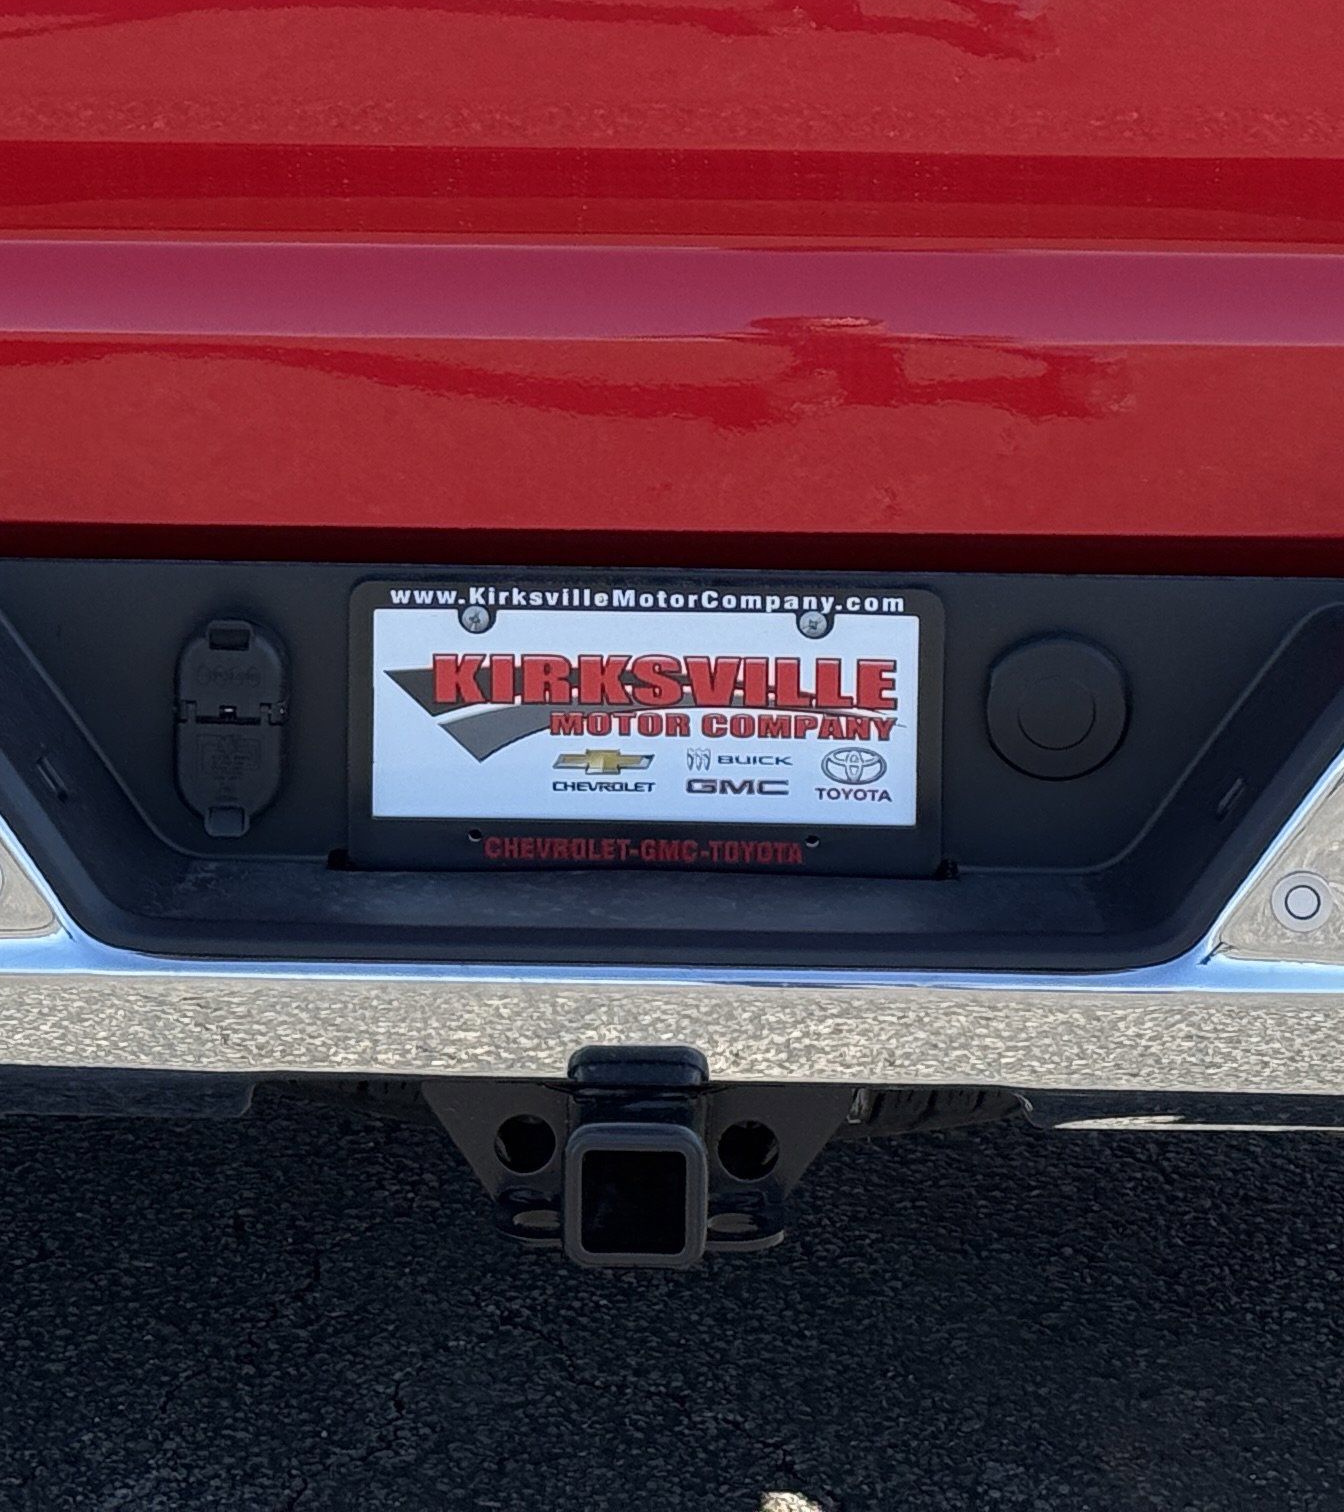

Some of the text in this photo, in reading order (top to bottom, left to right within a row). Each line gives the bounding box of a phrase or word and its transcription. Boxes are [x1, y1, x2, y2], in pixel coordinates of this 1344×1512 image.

[390, 587, 905, 613] www.KirksvilleMotorCompany.com
[431, 654, 898, 710] KIRKSVILLE
[549, 712, 897, 741] MOTOR COMPANY
[717, 755, 793, 766] BUICK
[552, 781, 656, 793] CHEVROLET
[685, 779, 790, 796] GMC
[816, 788, 892, 803] TOYOTA
[484, 836, 804, 865] CHEVROLET-GMC-TOYOTA
